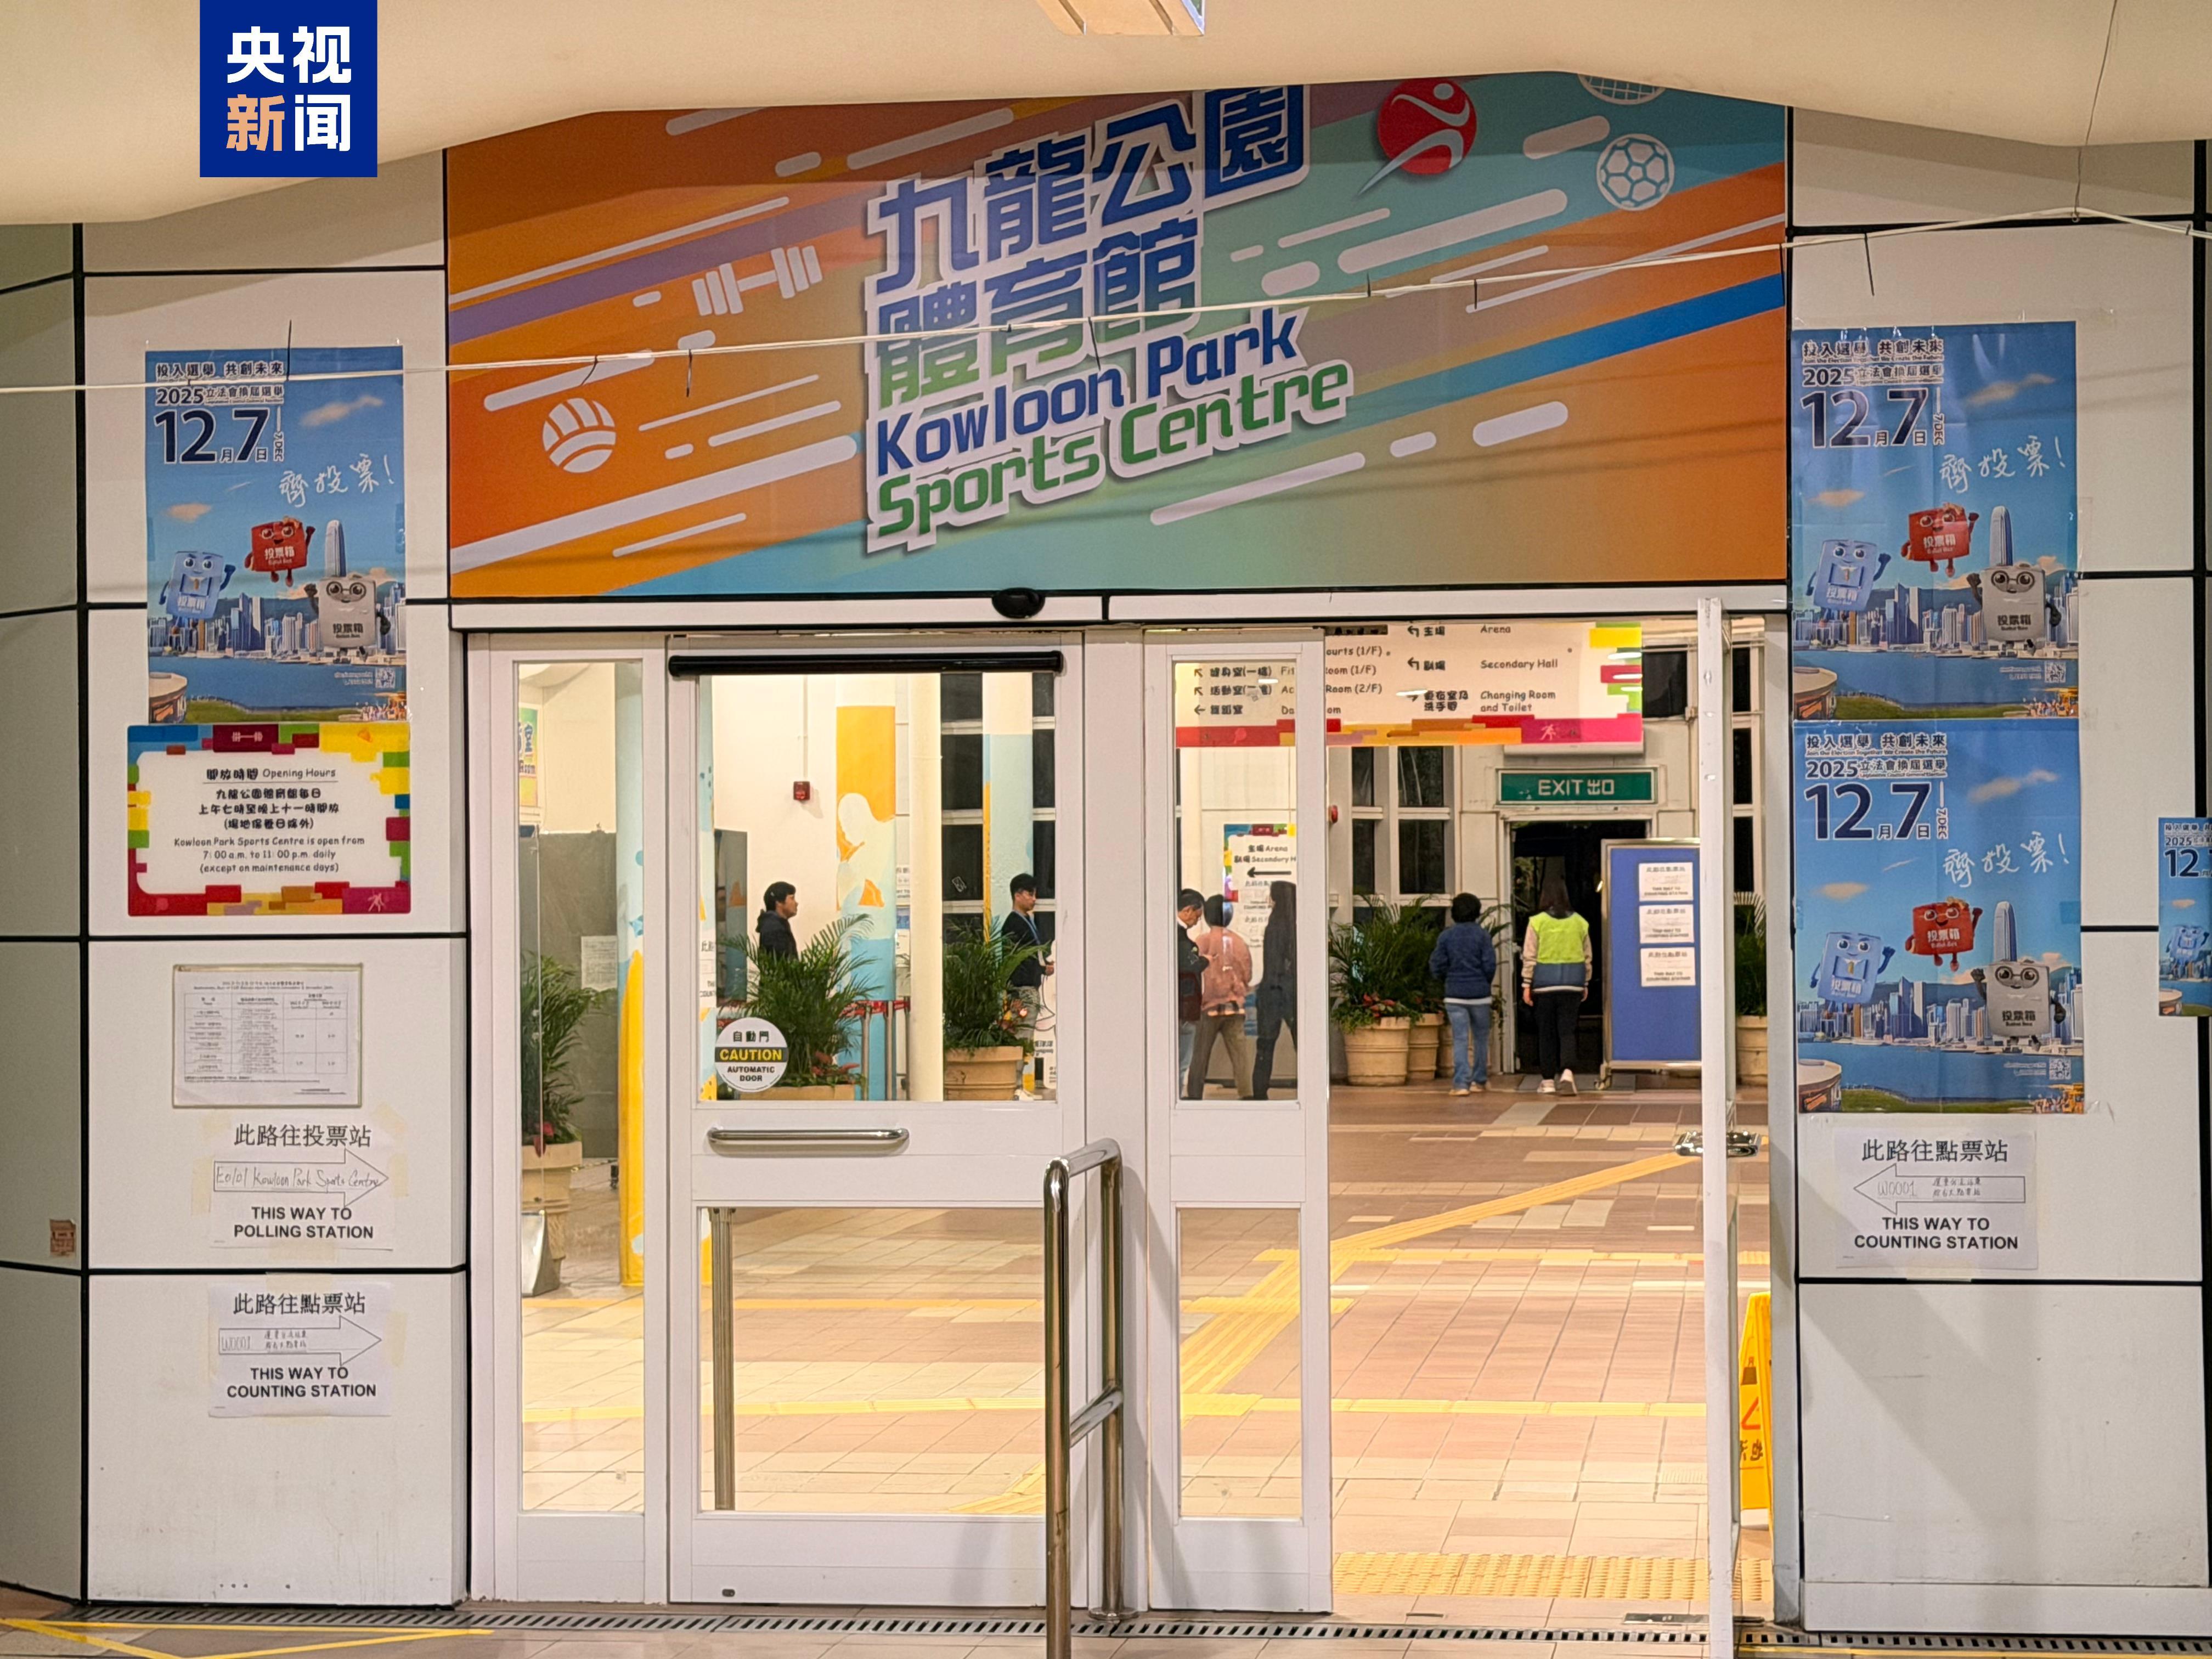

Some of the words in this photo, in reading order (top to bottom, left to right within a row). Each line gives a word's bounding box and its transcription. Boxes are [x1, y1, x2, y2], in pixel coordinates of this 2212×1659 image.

[878, 85, 1305, 294] 九龍公園
[878, 217, 1199, 411] 體育館
[1804, 341, 1867, 357] 投入選舉
[1879, 338, 1943, 354] 共創未來
[157, 363, 214, 377] 投入選舉
[225, 362, 283, 375] 共創未來
[878, 366, 1124, 477] Kowloon
[1147, 306, 1299, 399] Park
[1802, 389, 1928, 447] 12月7日
[155, 410, 269, 462] 12月7日
[878, 433, 1100, 538] Sports
[1119, 363, 1348, 465] Centre
[1481, 625, 1511, 634] Arena
[1356, 646, 1383, 657] (1/F)
[1351, 665, 1376, 676] (1/F)
[1481, 659, 1534, 670] Secondary
[1537, 658, 1558, 668] Hall
[1355, 684, 1383, 695] (2/F)
[1481, 690, 1526, 702] Changing
[1529, 691, 1556, 699] Room
[1481, 703, 1499, 712] and
[1502, 702, 1532, 712] Toilet
[1806, 735, 1870, 749] 投入選舉
[1882, 734, 1945, 747] 共創未來
[262, 769, 302, 780] Opening
[306, 768, 336, 777] Hours
[1538, 779, 1584, 795] EXIT
[1587, 779, 1615, 795] 出口
[1805, 783, 1931, 839] 12月7日
[174, 837, 212, 847] Kowloon
[213, 837, 235, 847] Park
[238, 837, 269, 848] Sports
[272, 836, 303, 845] Centre
[307, 836, 315, 845] is
[317, 838, 339, 847] open
[342, 836, 365, 845] from
[250, 850, 260, 859] to
[313, 850, 336, 860] daily
[200, 864, 236, 874] (except
[252, 863, 311, 872] maintenance
[313, 862, 340, 873] days)
[733, 1030, 769, 1043] 自動門
[719, 1048, 782, 1061] CAUTION
[234, 1123, 372, 1148] 此路往投票站
[1861, 1138, 2008, 1163] 此路往點票站
[294, 1167, 312, 1188] Park
[251, 1206, 286, 1220] THIS
[290, 1206, 326, 1220] WAY
[330, 1206, 352, 1221] TO
[234, 1224, 302, 1238] POLLING
[306, 1224, 374, 1239] STATION
[1882, 1217, 1919, 1231] THIS
[1924, 1217, 1962, 1231] WAY
[1967, 1217, 1990, 1231] TO
[1854, 1234, 1942, 1249] COUNTING
[1946, 1235, 2018, 1250] STATION
[233, 1291, 365, 1315] 此路往點票站
[250, 1367, 284, 1380] THIS
[289, 1366, 324, 1380] WAY
[328, 1366, 349, 1379] TO
[227, 1385, 306, 1398] COUNTING
[311, 1384, 377, 1397] STATION
